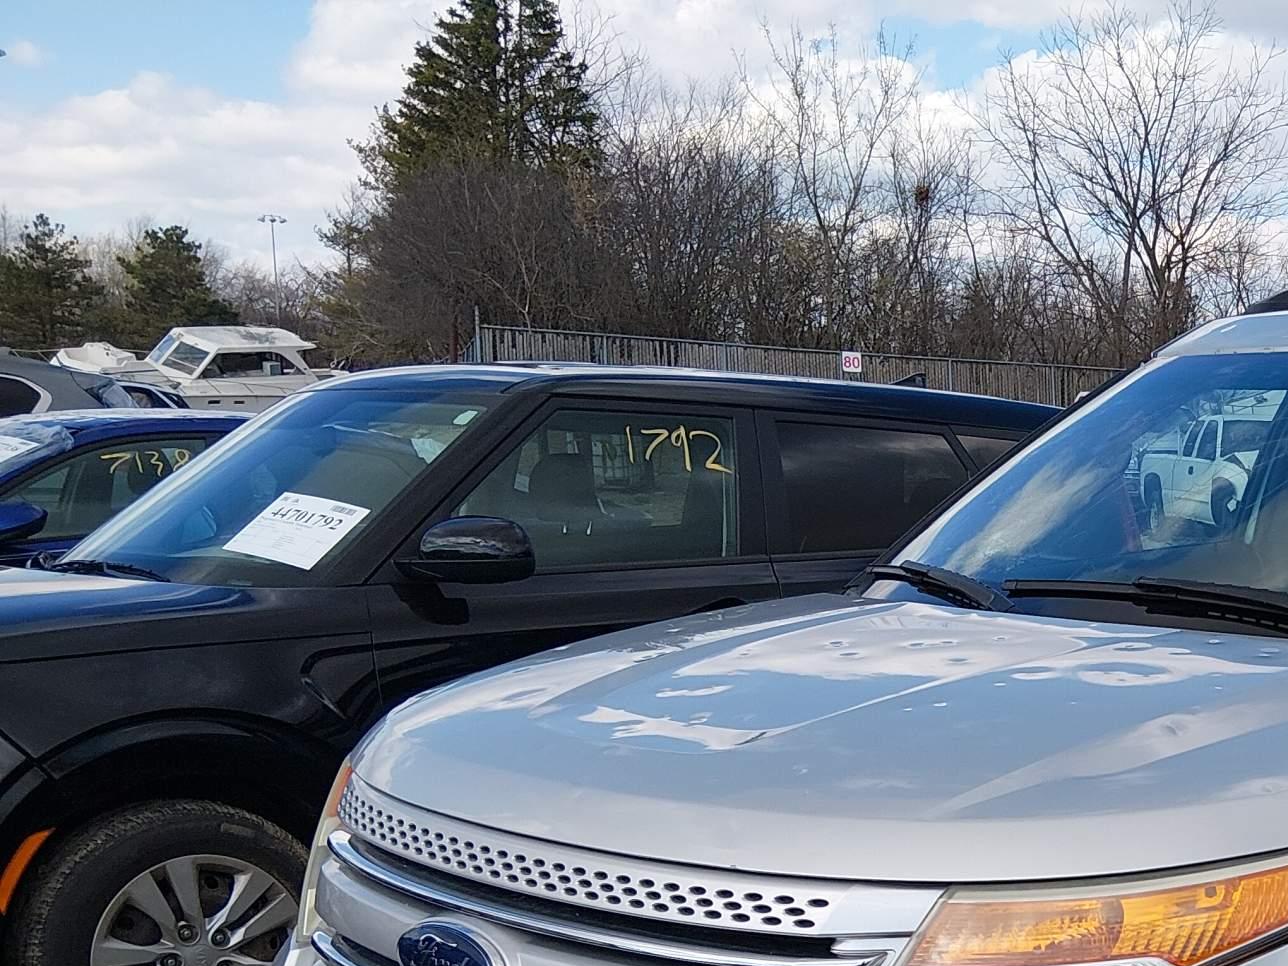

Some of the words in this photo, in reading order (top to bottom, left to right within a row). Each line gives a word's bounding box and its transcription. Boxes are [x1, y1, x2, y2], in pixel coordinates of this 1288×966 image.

[844, 356, 860, 369] 80
[625, 424, 733, 474] 1792
[271, 506, 344, 531] 44701792
